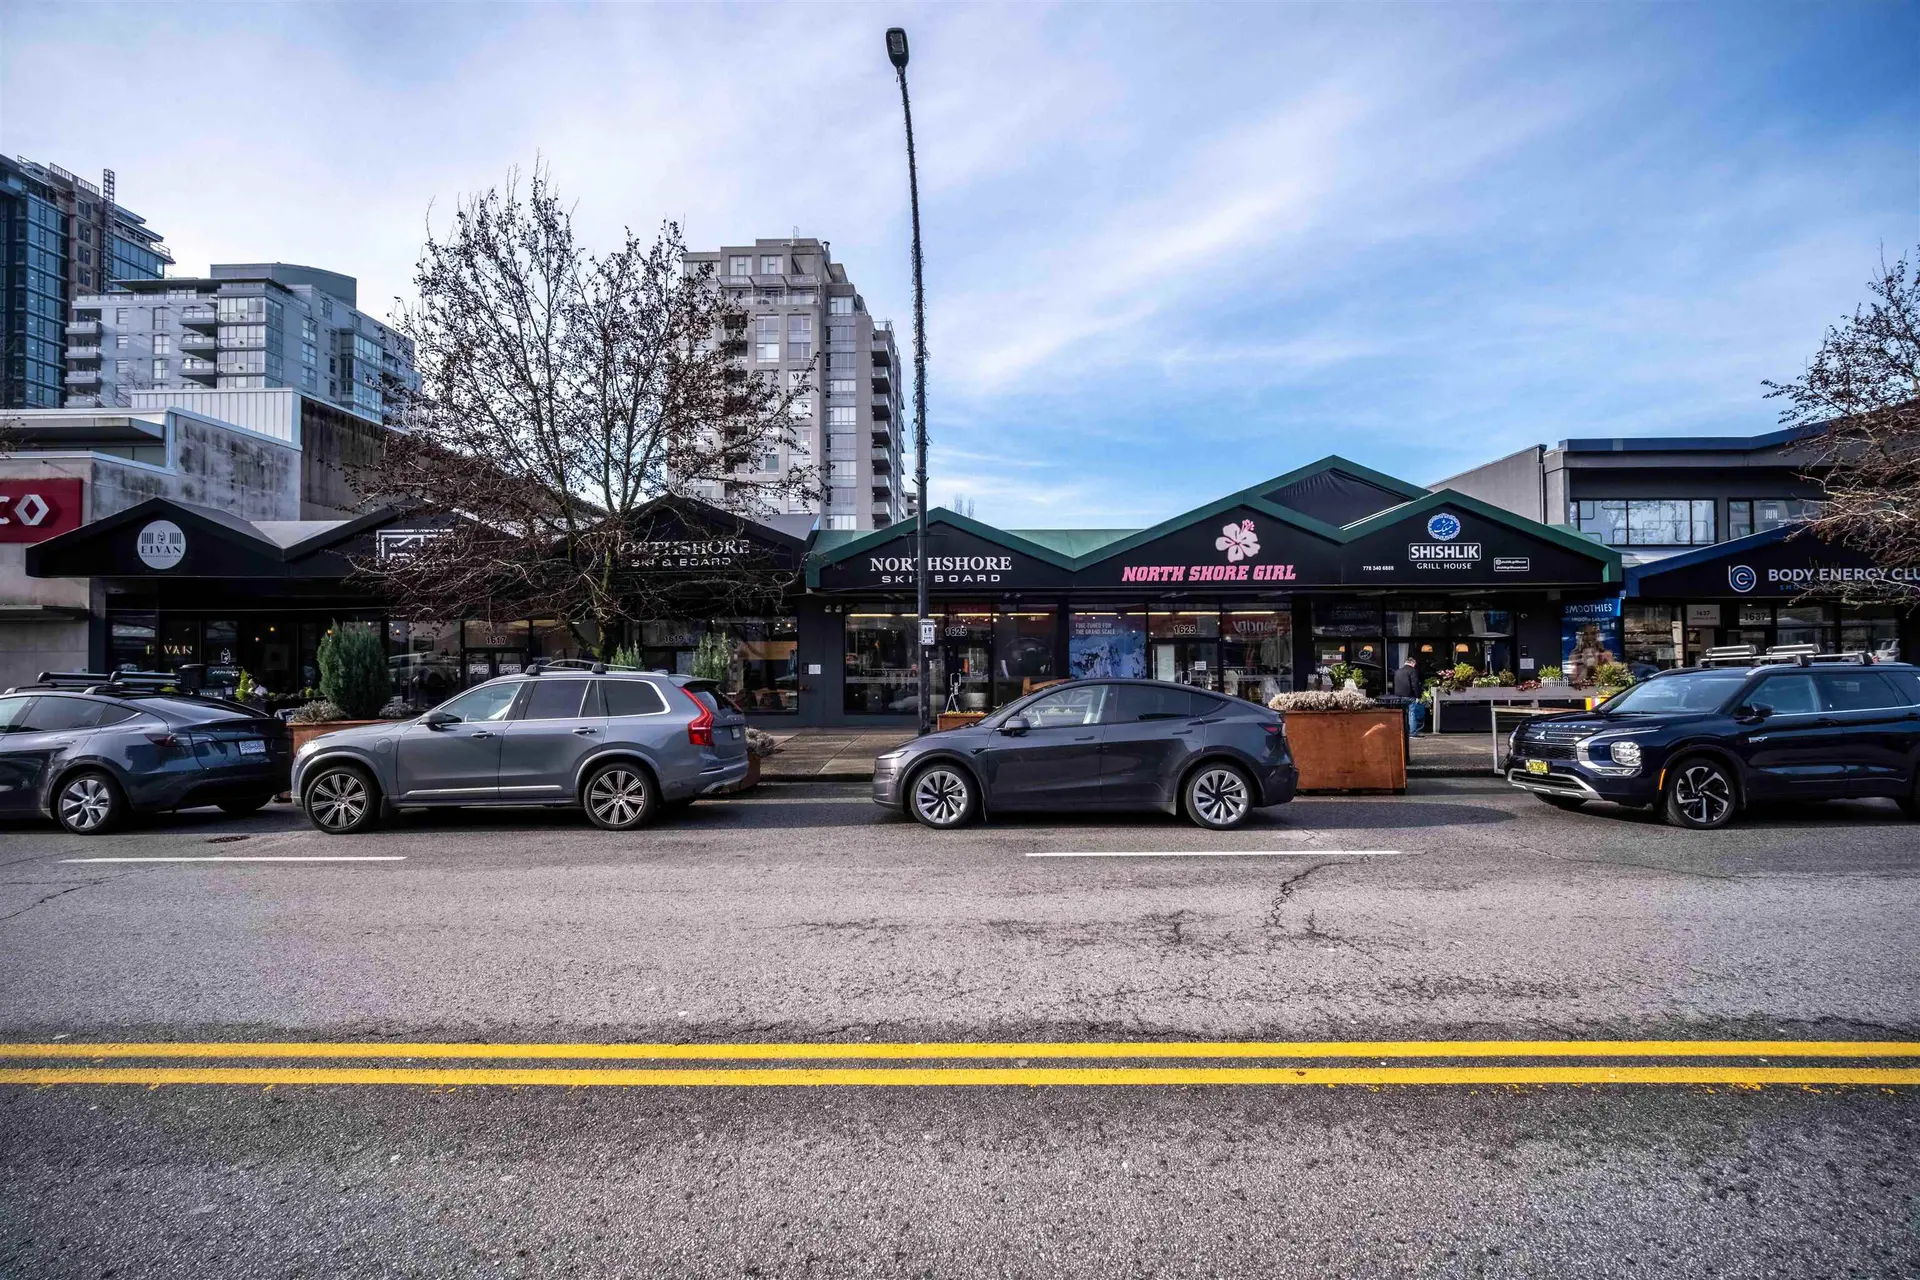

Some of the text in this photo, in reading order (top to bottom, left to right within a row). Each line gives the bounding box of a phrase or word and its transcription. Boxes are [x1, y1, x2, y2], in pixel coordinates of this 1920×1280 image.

[141, 545, 181, 554] EIVAN
[619, 540, 750, 556] ORTHSHORE
[1410, 545, 1479, 559] SHISHLIK
[679, 557, 731, 567] BOARD
[1416, 562, 1472, 570] GRILL HOUSE
[1122, 564, 1297, 582] NORTH SHORE GIRL
[1768, 568, 1814, 582] BODY
[1819, 568, 1888, 581] ENERGY
[881, 574, 1001, 583] SKI BOARD
[1565, 603, 1613, 614] SMOOTHIES
[1744, 612, 1767, 621] 1637
[945, 627, 967, 636] 1625
[1174, 624, 1197, 634] 1625
[486, 635, 507, 645] 1617
[664, 634, 684, 644] 1619
[145, 645, 193, 655] EVAN
[471, 665, 488, 673] F45
[501, 665, 520, 673] F45
